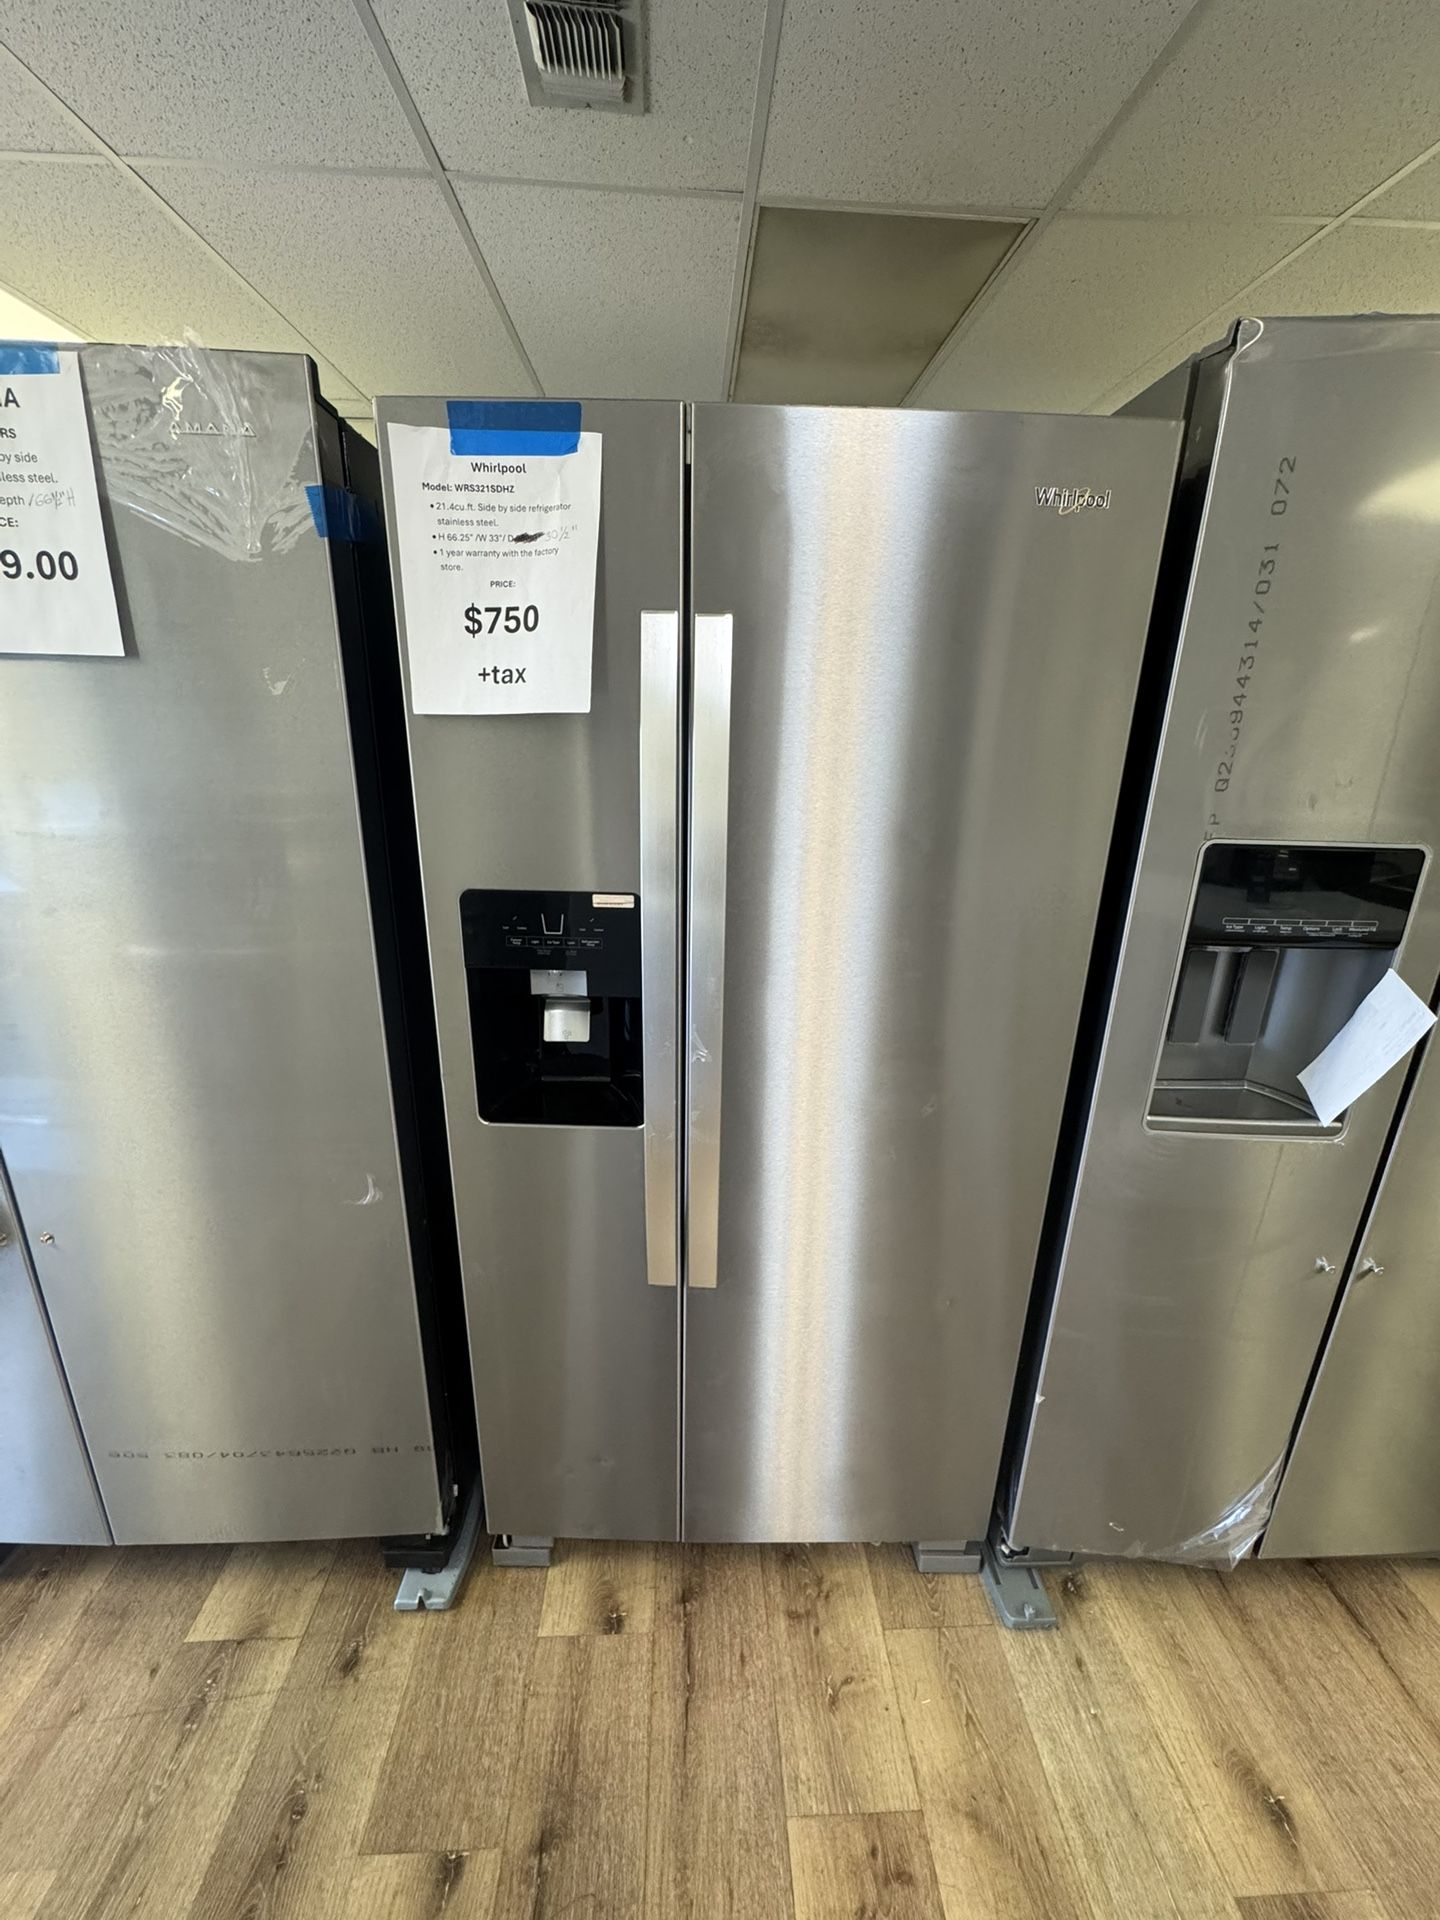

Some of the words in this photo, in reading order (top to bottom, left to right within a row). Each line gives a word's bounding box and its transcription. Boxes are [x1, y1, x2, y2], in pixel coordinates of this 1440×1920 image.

[0, 387, 20, 408] A
[14, 452, 38, 463] side
[470, 462, 527, 475] Whirlpool
[0, 473, 26, 483] less
[27, 473, 58, 483] steel.
[422, 482, 452, 492] Model:
[1271, 456, 1297, 516] 072
[1034, 486, 1112, 513] Whirlpool
[477, 502, 496, 512] Side
[498, 503, 508, 514] by
[510, 504, 526, 512] side
[529, 503, 571, 514] refrigerator
[437, 517, 474, 526] stainless
[476, 518, 500, 526] steel.
[446, 549, 464, 558] year
[466, 549, 500, 559] warranty
[502, 549, 519, 557] with
[520, 549, 533, 557] the
[534, 547, 559, 556] factory
[0, 549, 78, 581] 9.00
[490, 580, 516, 588] PRICE:
[464, 602, 539, 638] $750
[478, 666, 527, 684] +tax
